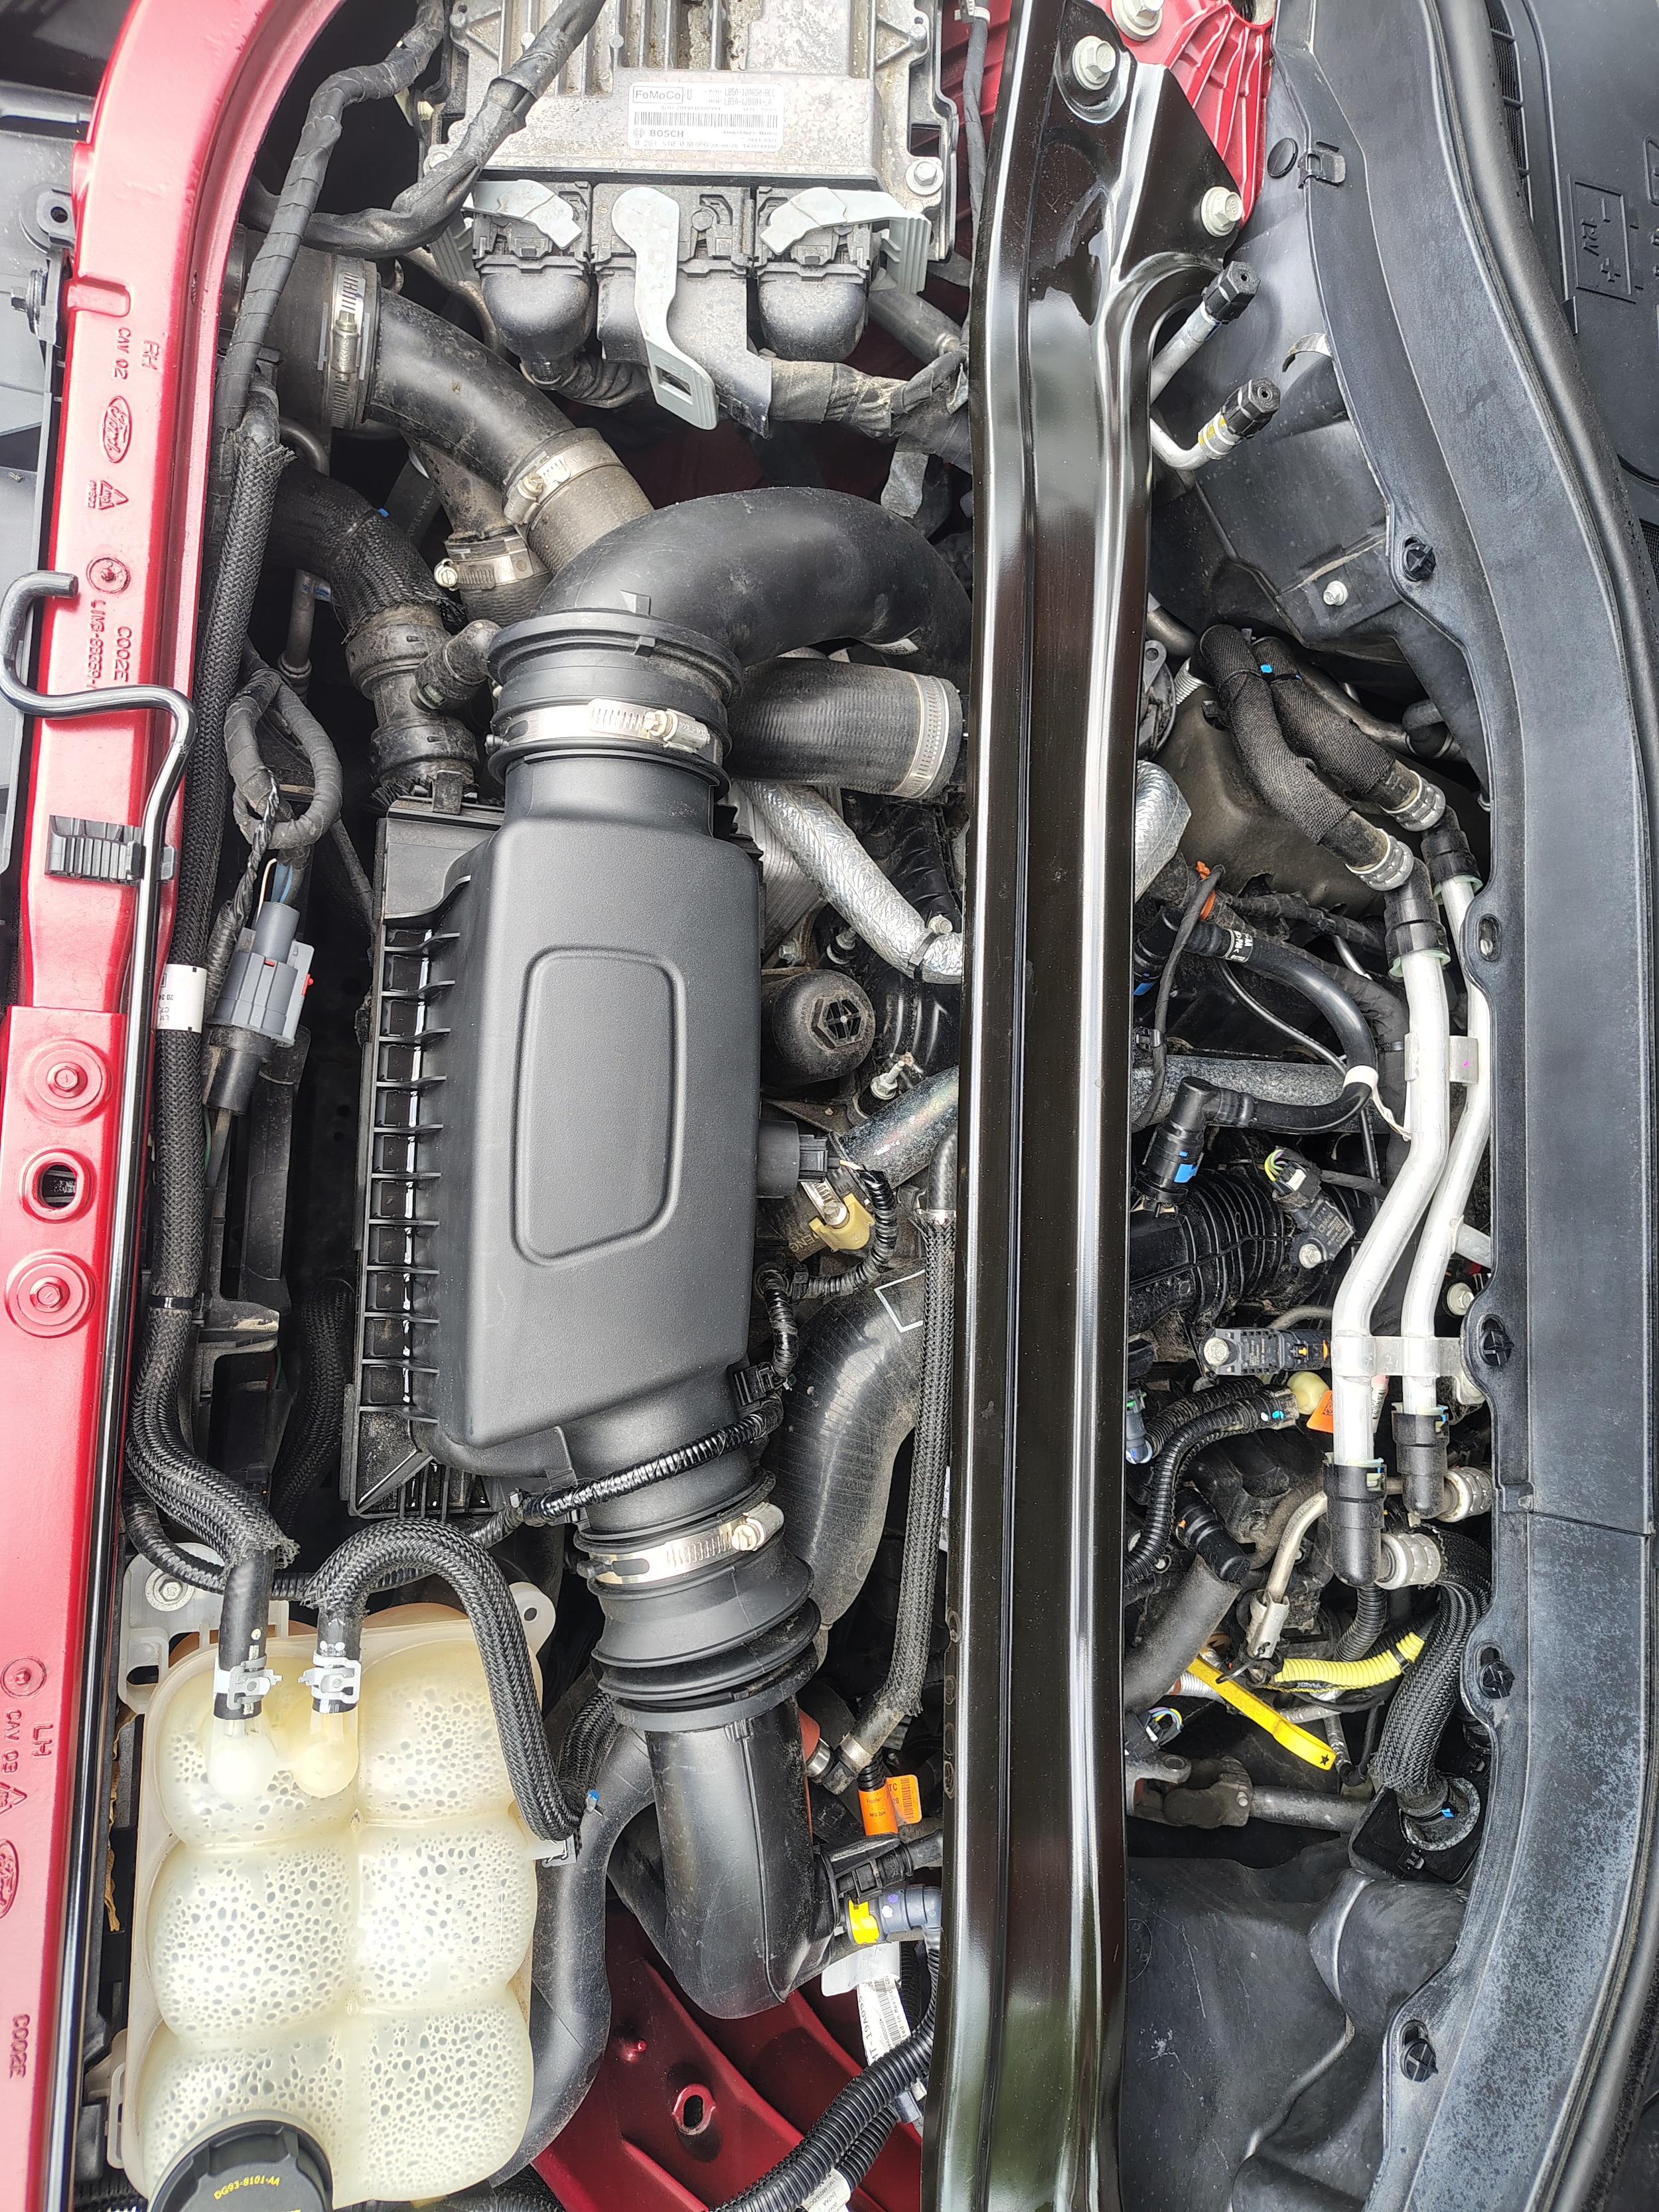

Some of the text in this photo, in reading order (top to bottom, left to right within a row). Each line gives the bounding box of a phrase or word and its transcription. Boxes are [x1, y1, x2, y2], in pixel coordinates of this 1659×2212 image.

[635, 90, 681, 100] FoMoCo
[649, 129, 684, 138] BOSCH
[113, 327, 132, 380] CAV 02
[141, 340, 160, 370] RH
[106, 404, 129, 455] Ford
[113, 626, 133, 683] C002E
[5, 1709, 23, 1741] CAV
[33, 1723, 54, 1757] LH
[9, 2014, 31, 2079] C002E
[213, 2174, 281, 2200] DG93-8101-AA
